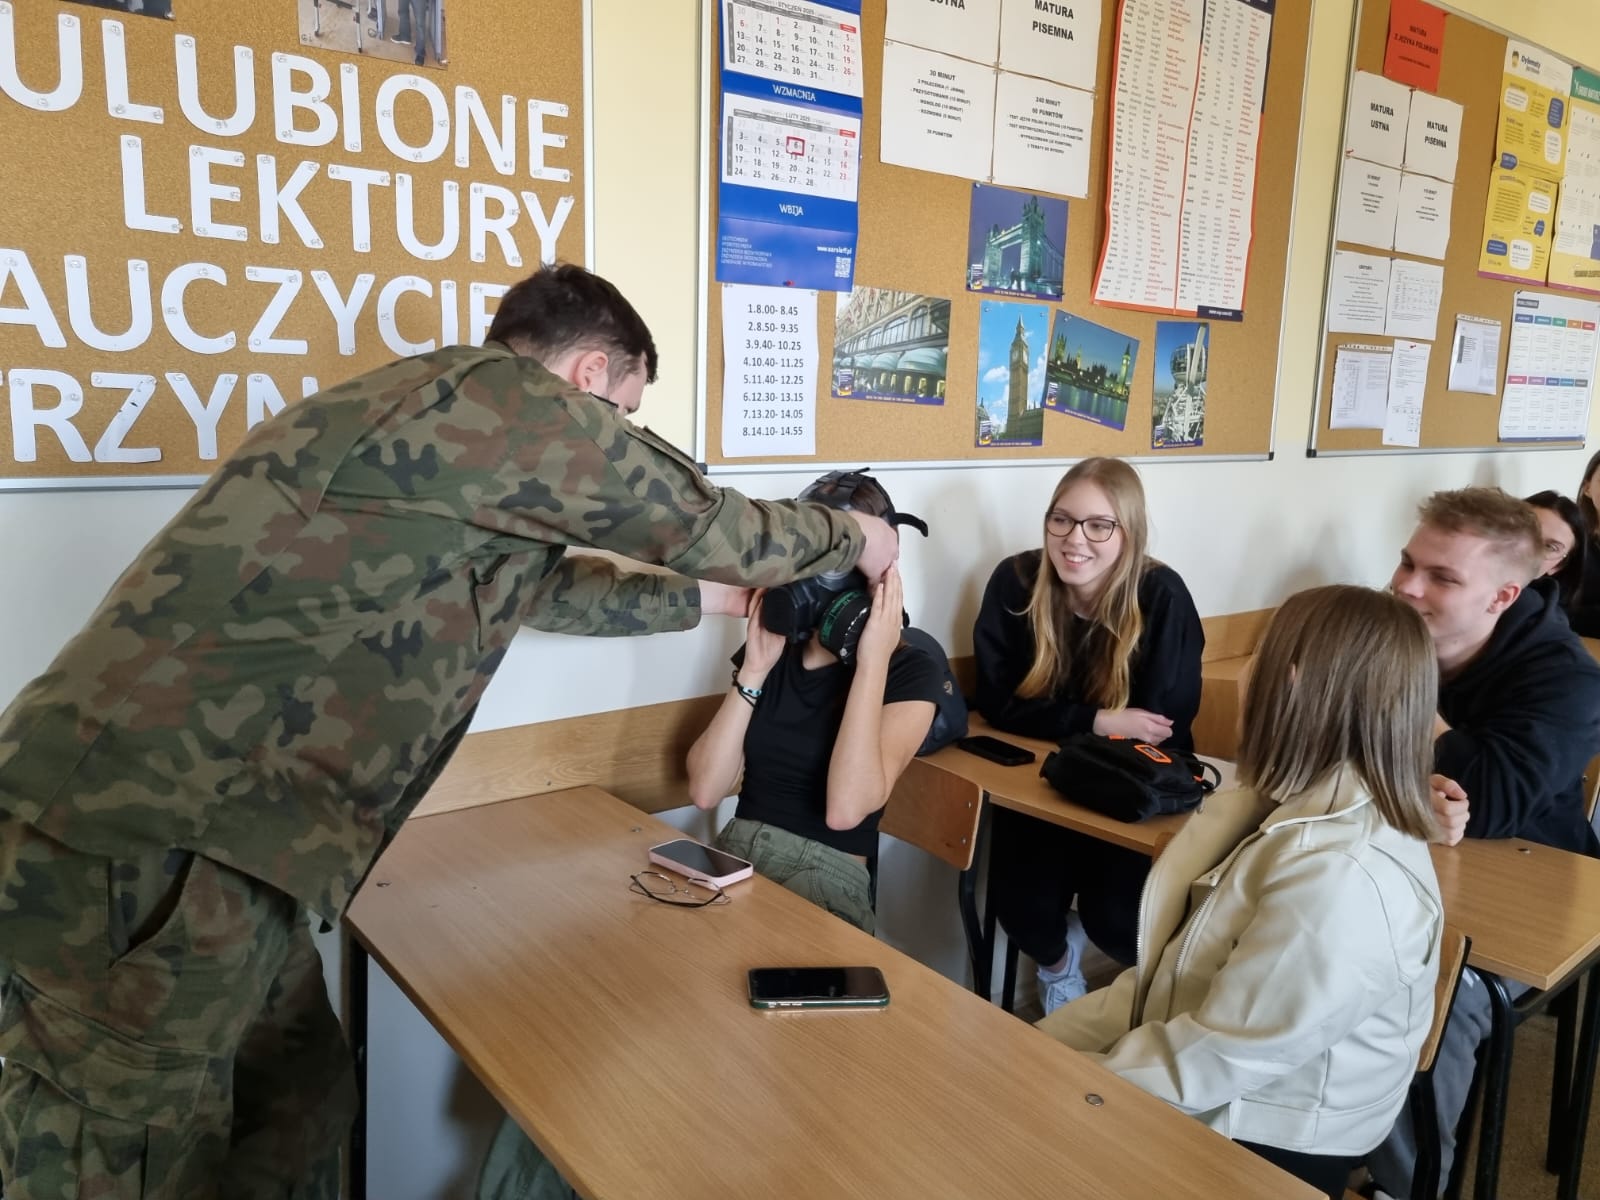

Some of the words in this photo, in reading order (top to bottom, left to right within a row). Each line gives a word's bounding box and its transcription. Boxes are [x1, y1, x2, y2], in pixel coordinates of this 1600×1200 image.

[930, 0, 965, 10] TNA
[1035, 0, 1074, 19] MATURA
[740, 19, 744, 27] 6
[810, 36, 816, 44] 10
[1032, 21, 1074, 41] PISEMNA
[737, 31, 745, 39] 13
[773, 40, 781, 48] 15
[792, 44, 799, 52] 16
[810, 48, 817, 56] 17
[844, 56, 850, 64] 19
[737, 43, 745, 51] 20
[756, 48, 763, 56] 21
[774, 52, 781, 60] 22
[792, 56, 799, 64] 23
[844, 67, 851, 75] 26
[737, 55, 745, 63] 27
[774, 63, 782, 71] 29
[792, 67, 800, 75] 30
[810, 71, 817, 79] 31
[938, 72, 955, 80] MINUT
[0, 0, 573, 183] ULUBIONE
[772, 84, 816, 102] WZMACNIA
[786, 112, 798, 120] LUTY
[1370, 102, 1394, 117] MATURA
[1371, 120, 1390, 132] USTNA
[1427, 120, 1448, 133] MATURA
[1424, 136, 1446, 148] PISEMNA
[121, 135, 574, 267] LEKTURY
[779, 204, 804, 217] WBIJA
[748, 303, 778, 315] 1.8.00-
[780, 306, 798, 316] 8.45
[748, 322, 778, 332] 2.8.50-
[780, 323, 799, 333] 9.35
[746, 339, 775, 350] 3.9.40-
[778, 341, 801, 351] 10.25
[743, 357, 778, 367] 4.10.40-
[781, 358, 804, 368] 11.25
[744, 375, 778, 384] 5.11.40-
[781, 375, 804, 385] 12.25
[743, 392, 778, 402] 6.12.30-
[781, 392, 803, 402] 13.15
[743, 409, 778, 419] 7.13.20-
[781, 410, 803, 419] 14.05
[743, 426, 778, 436] 8.14.10-
[780, 427, 803, 436] 14.55
